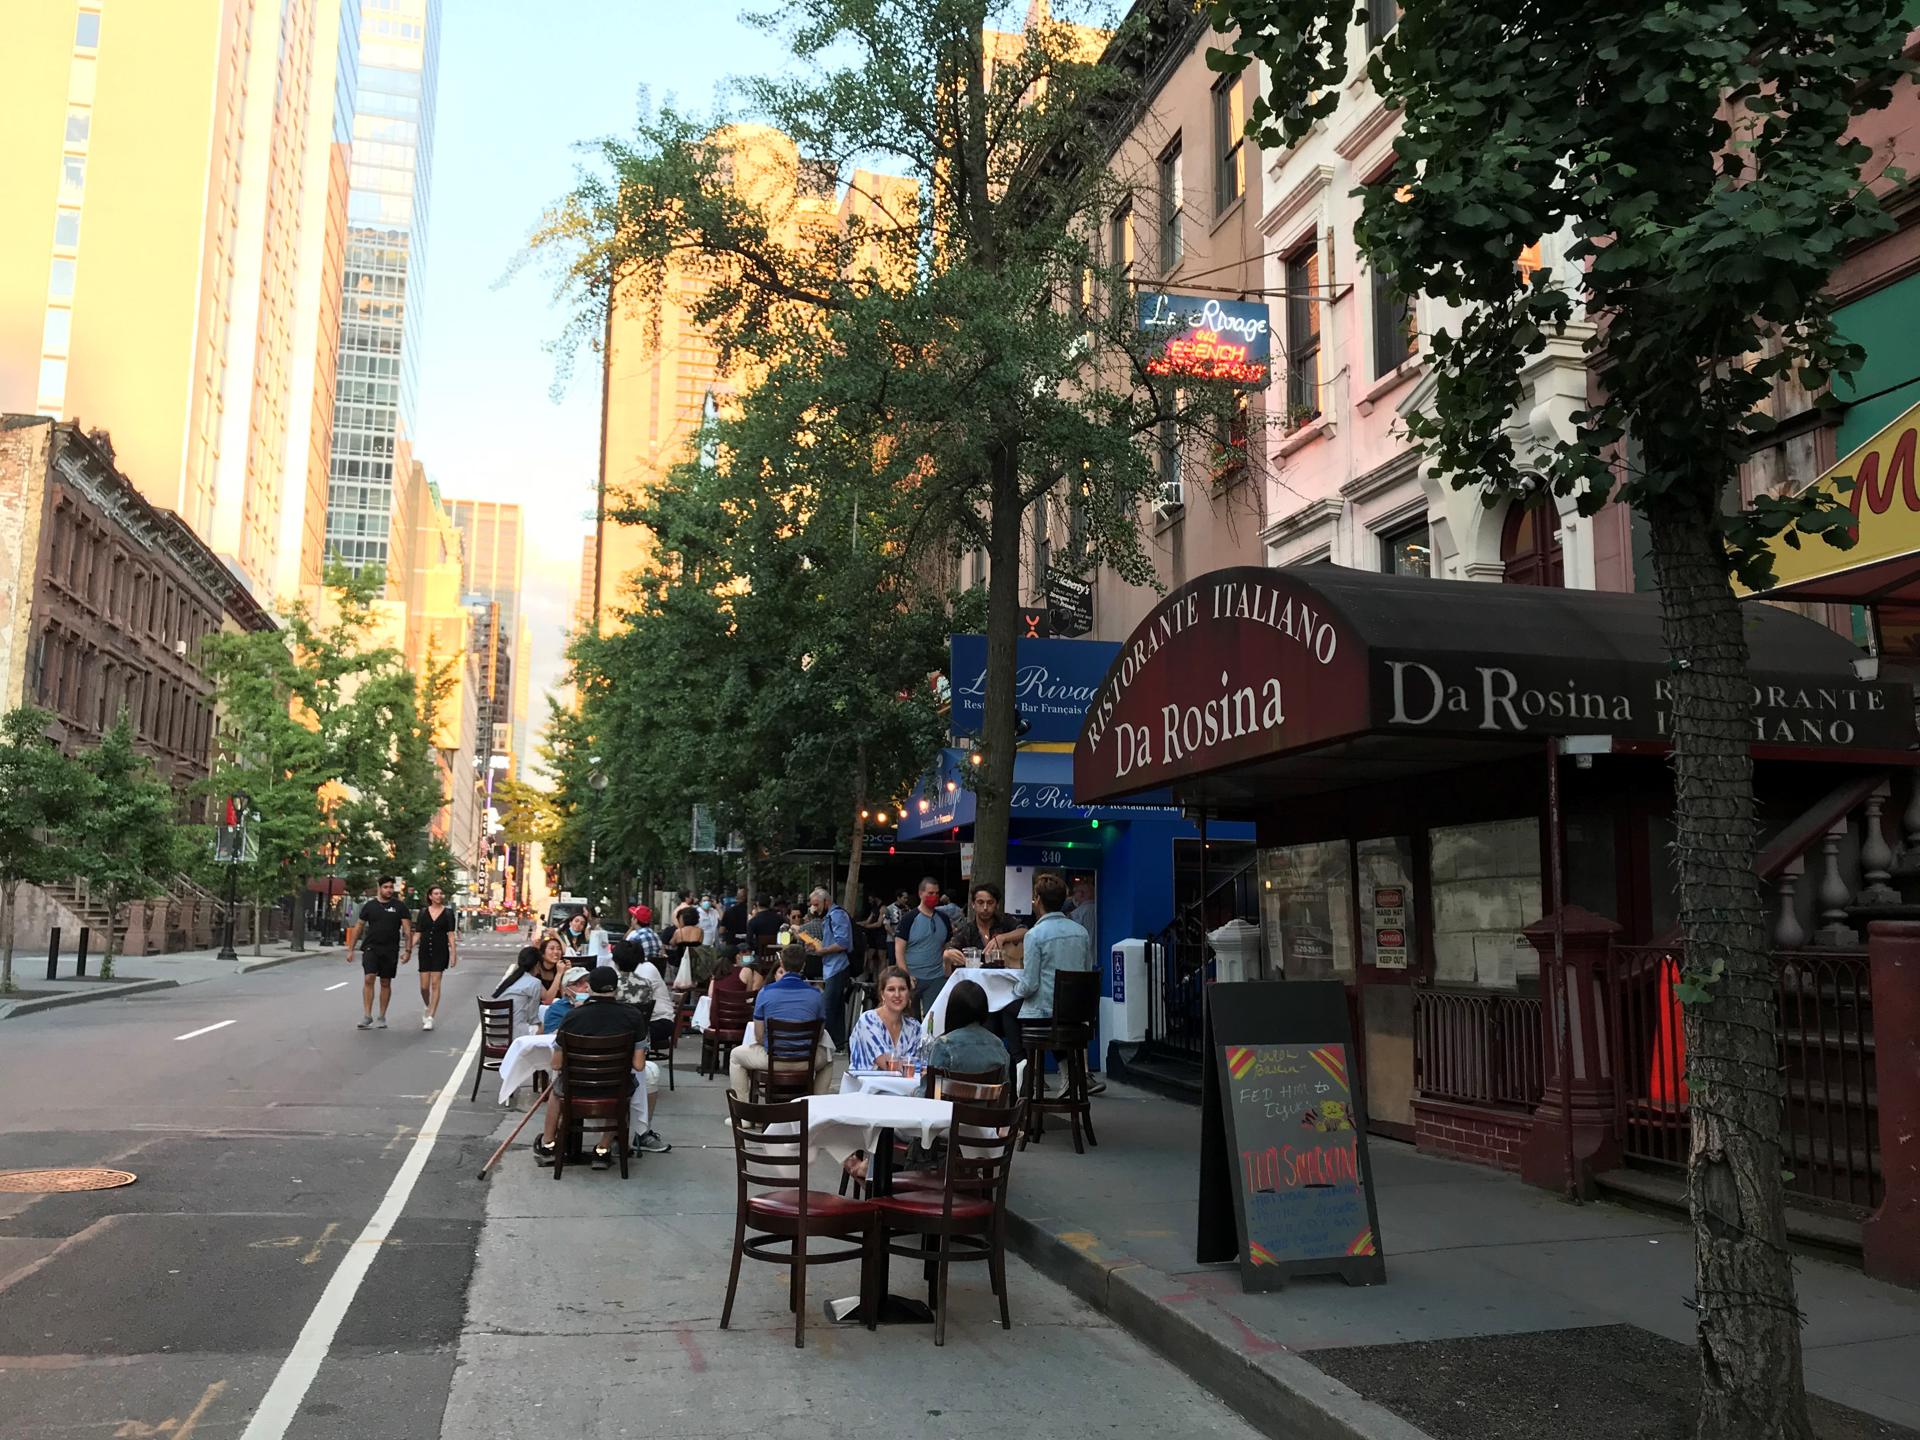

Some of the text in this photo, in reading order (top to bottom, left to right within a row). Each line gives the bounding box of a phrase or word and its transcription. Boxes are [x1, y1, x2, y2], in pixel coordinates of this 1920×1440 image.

[1144, 295, 1267, 342] Le Rivage
[959, 665, 1098, 701] L Riva
[1087, 582, 1336, 753] RISTORANTE ITALIANO
[1022, 702, 1039, 713] Bar
[1042, 703, 1082, 714] Français
[1475, 667, 1633, 731] Rosina
[1655, 678, 1885, 711] RRANTE
[1115, 670, 1285, 778] Da Rosina
[1657, 711, 1854, 744] IIANO
[1010, 785, 1030, 808] Le
[1041, 850, 1061, 864] 340
[1378, 934, 1400, 942] DANGER
[1394, 956, 1403, 964] OUT
[1240, 1088, 1273, 1104] FED
[1314, 1081, 1330, 1094] to
